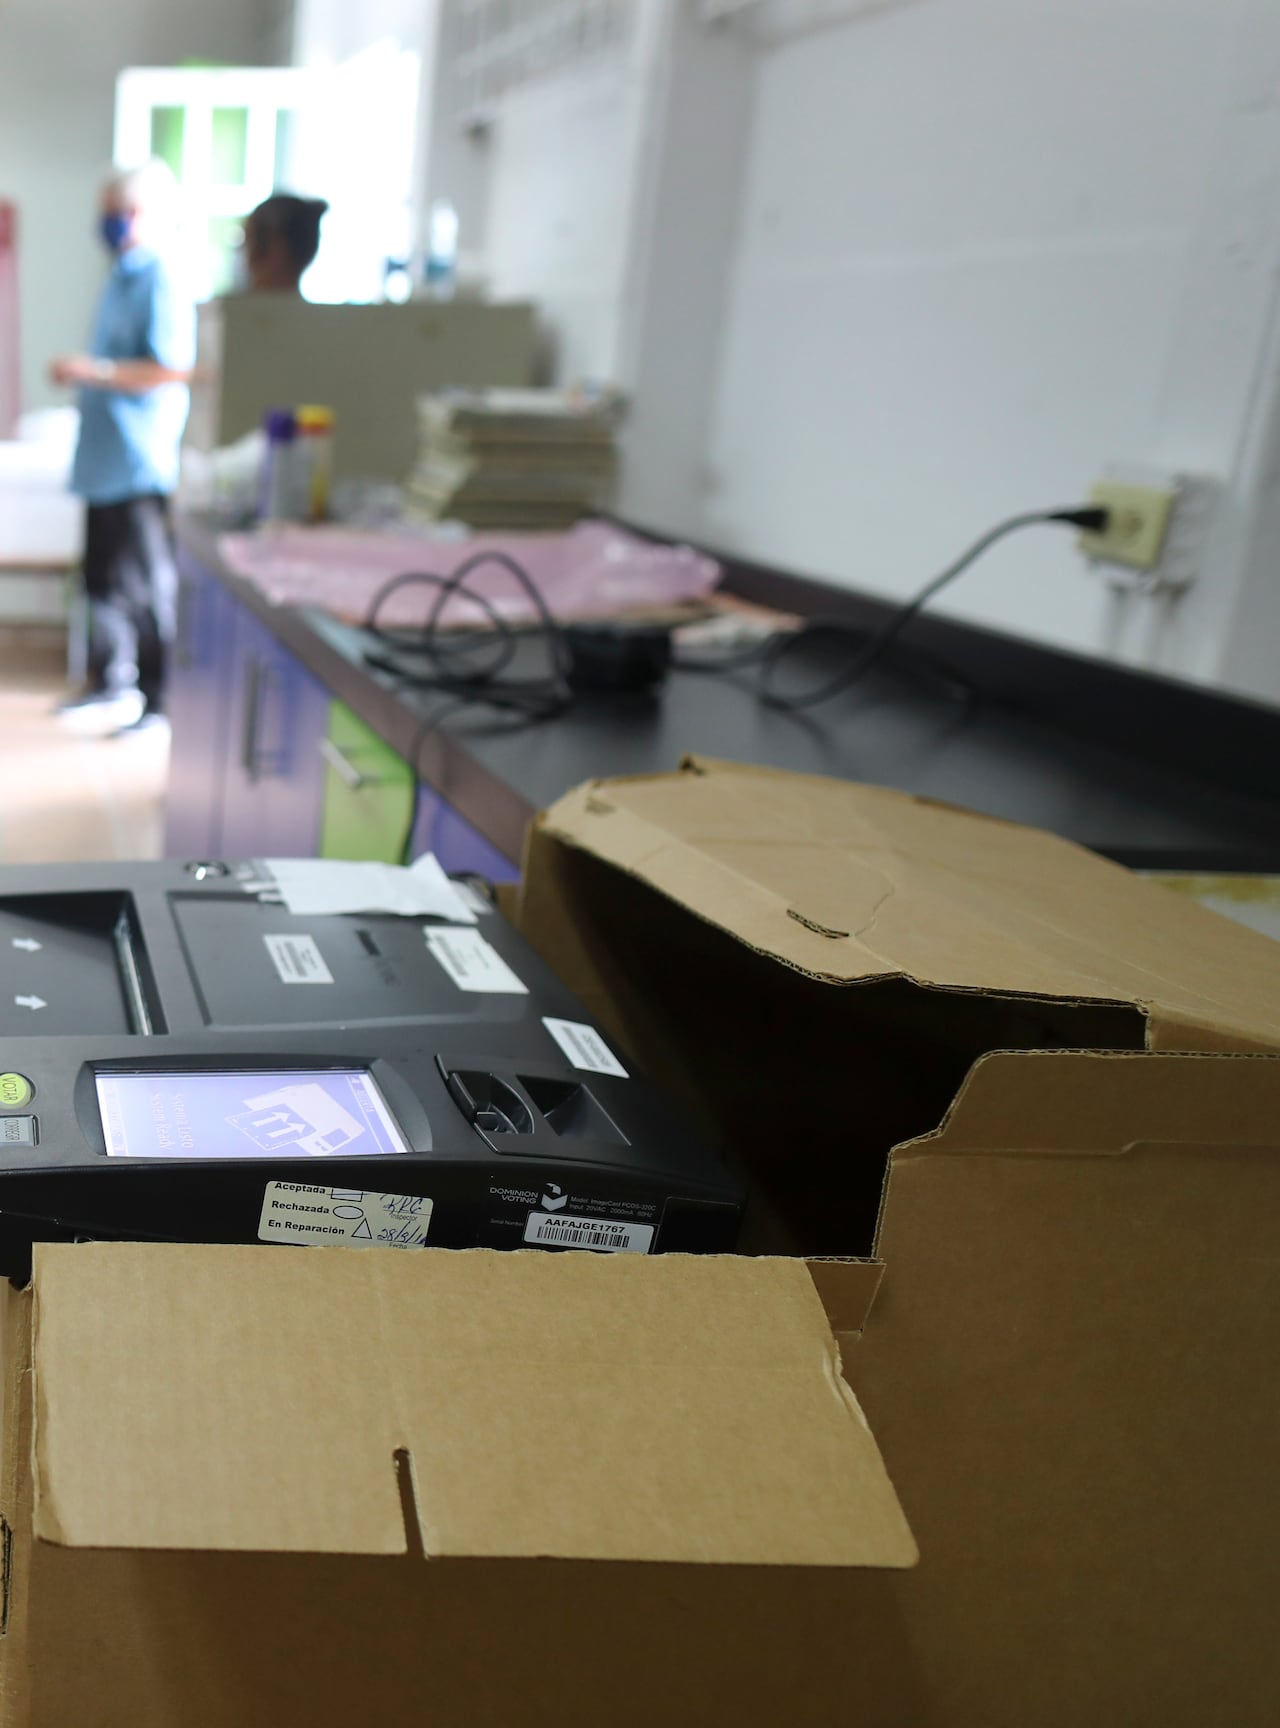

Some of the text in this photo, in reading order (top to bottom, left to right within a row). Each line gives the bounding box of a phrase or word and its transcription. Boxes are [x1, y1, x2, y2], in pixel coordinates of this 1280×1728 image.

[2, 1077, 18, 1100] VOTAR
[274, 1182, 326, 1195] Aceptada
[489, 1187, 538, 1199] DOMINION
[502, 1195, 537, 1204] VOTING
[271, 1200, 329, 1214] Rechazada
[390, 1213, 418, 1221] Inspector
[268, 1219, 345, 1235] En Reparación
[545, 1218, 625, 1233] AAFAJGE1767
